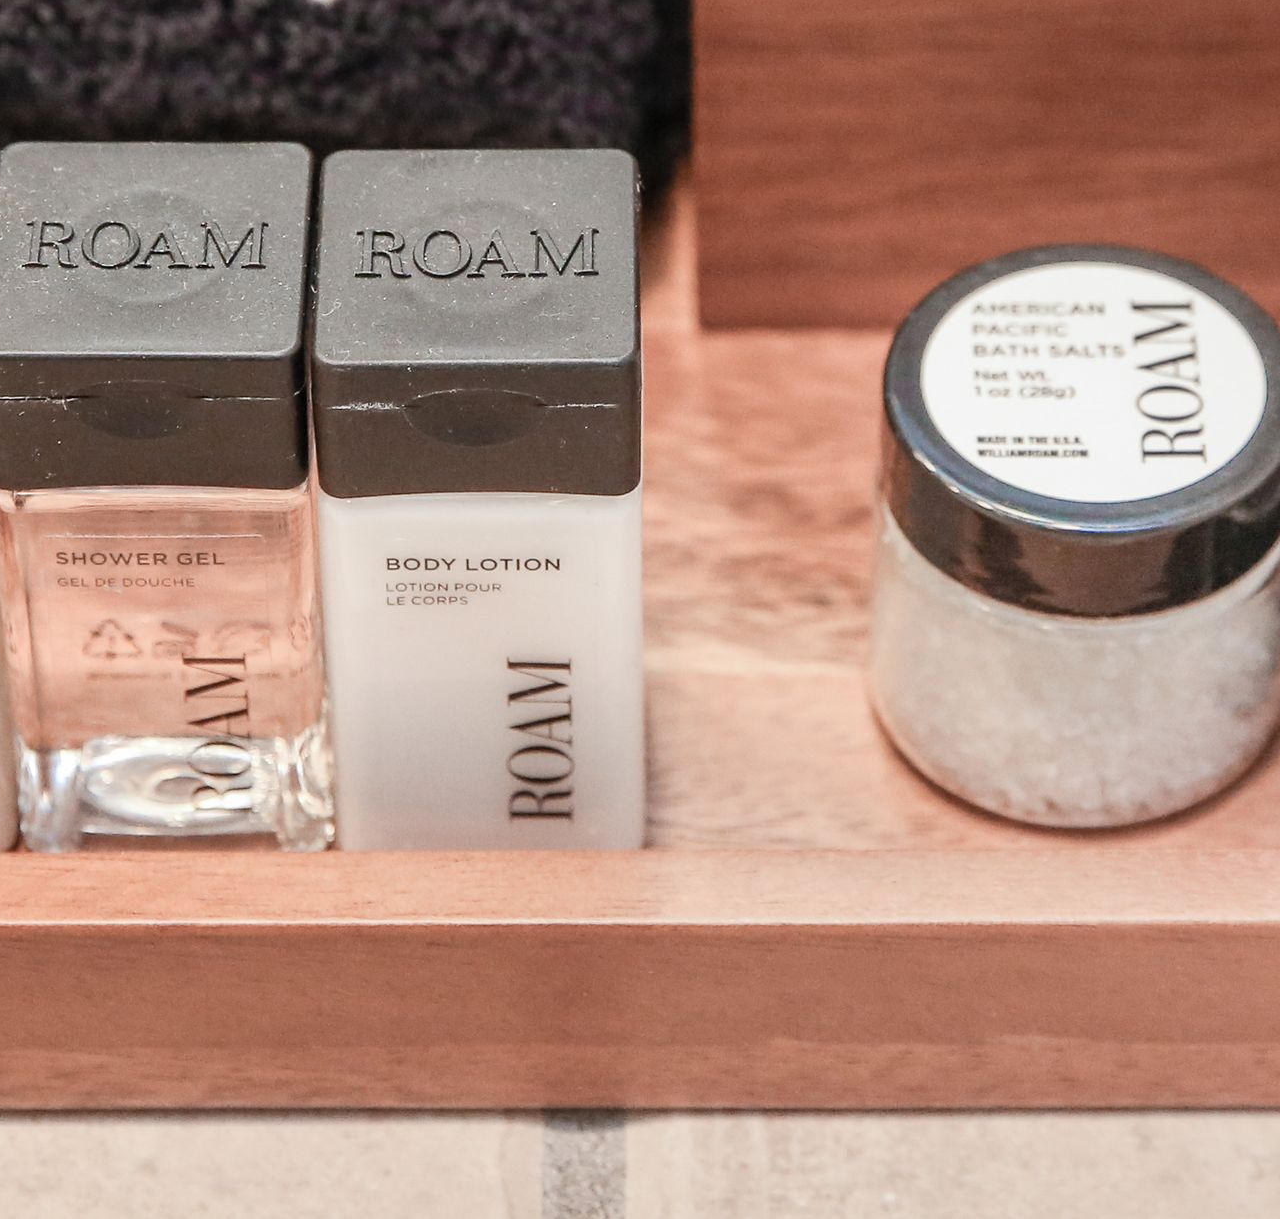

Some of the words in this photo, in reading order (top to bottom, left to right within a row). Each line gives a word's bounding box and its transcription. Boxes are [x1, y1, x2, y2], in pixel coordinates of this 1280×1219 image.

[21, 220, 270, 270] ROAM
[353, 227, 600, 279] ROAM
[972, 302, 1105, 316] AMERICAN
[972, 323, 1069, 337] PACIFIC
[973, 344, 1039, 357] BATH
[1049, 344, 1125, 358] SALTS
[974, 370, 1008, 381] Net
[1130, 298, 1207, 464] ROAM
[974, 385, 982, 397] 1
[988, 388, 1010, 398] oz
[1019, 385, 1076, 399] (28g)
[55, 551, 168, 566] SHOWER
[177, 551, 226, 566] GEL
[386, 557, 456, 571] BODY
[465, 557, 561, 571] LOTION
[57, 577, 90, 588] GEL
[95, 577, 117, 588] DE
[122, 577, 196, 588] DOUCHE
[385, 582, 449, 593] LOTION
[454, 582, 503, 593] POUR
[386, 596, 406, 606] LE
[411, 596, 470, 606] CORPS
[182, 653, 254, 813] ROAM
[506, 655, 576, 822] ROAM
